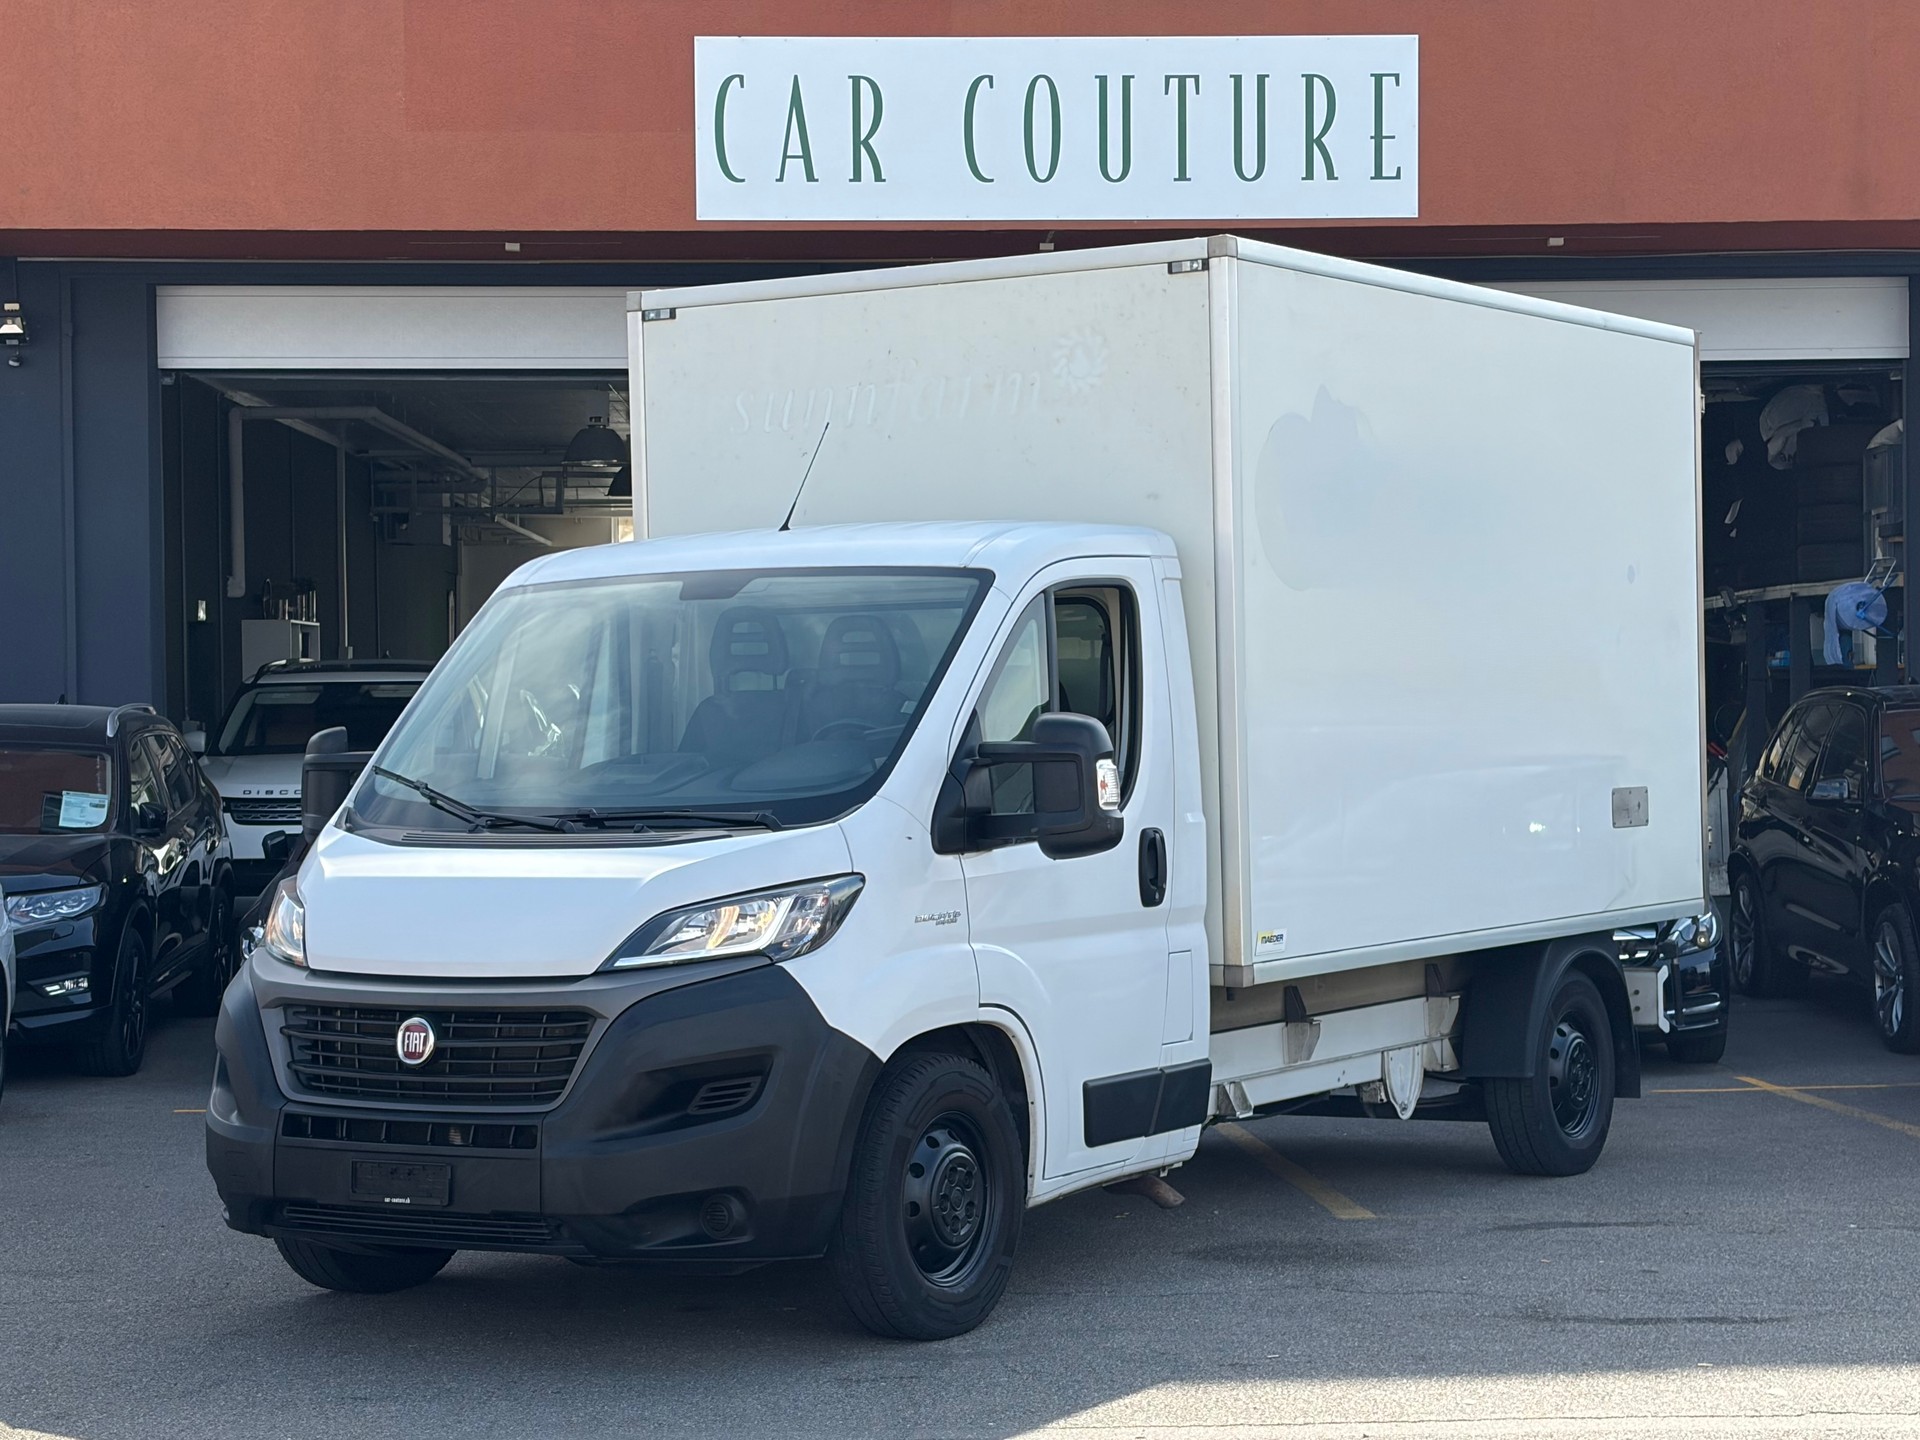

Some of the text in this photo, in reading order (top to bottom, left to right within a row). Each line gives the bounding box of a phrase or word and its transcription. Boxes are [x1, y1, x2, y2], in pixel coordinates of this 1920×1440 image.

[714, 72, 1402, 184] CAR COUTURE
[404, 1031, 426, 1053] FIAT
